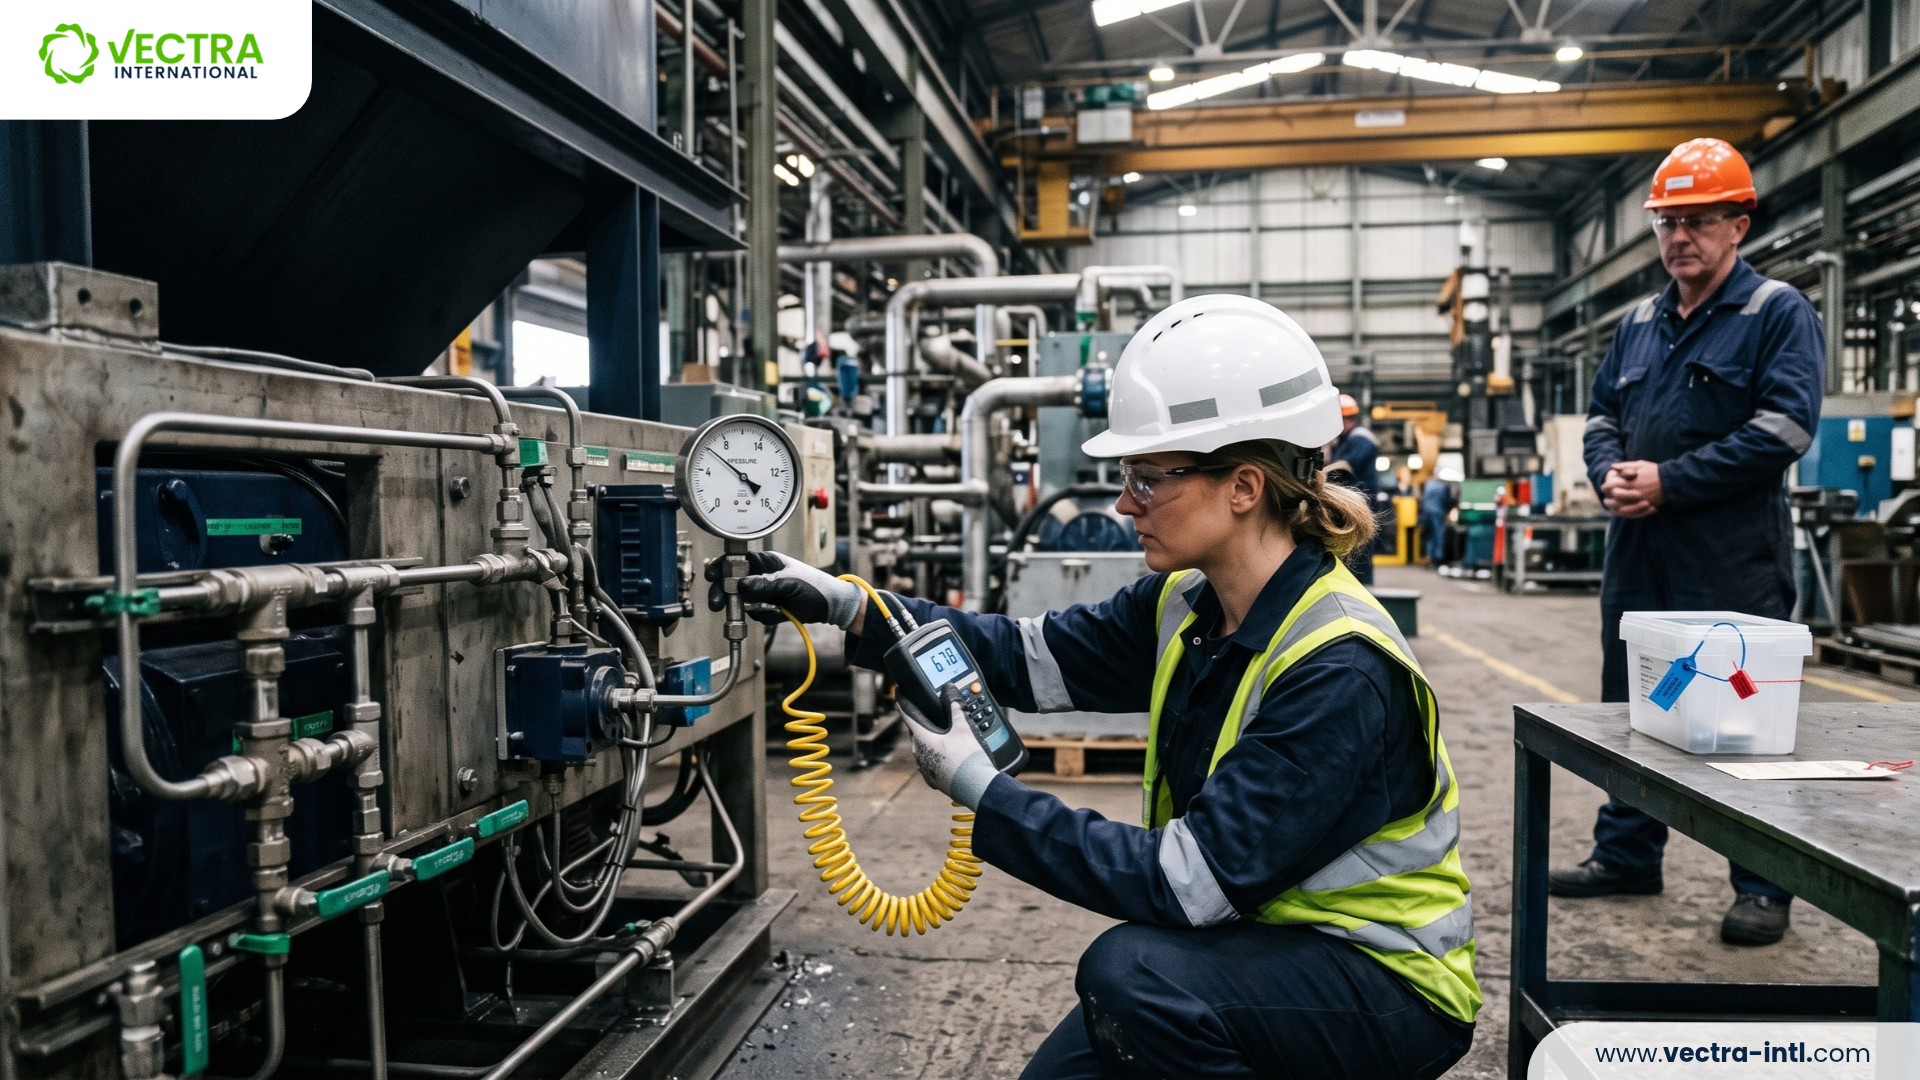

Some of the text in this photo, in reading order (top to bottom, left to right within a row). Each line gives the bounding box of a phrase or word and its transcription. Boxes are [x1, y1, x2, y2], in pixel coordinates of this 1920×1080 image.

[723, 441, 729, 451] 8
[754, 441, 763, 451] 14
[705, 467, 711, 477] 4
[770, 467, 780, 478] 12
[714, 498, 720, 507] 0
[760, 498, 770, 508] 16
